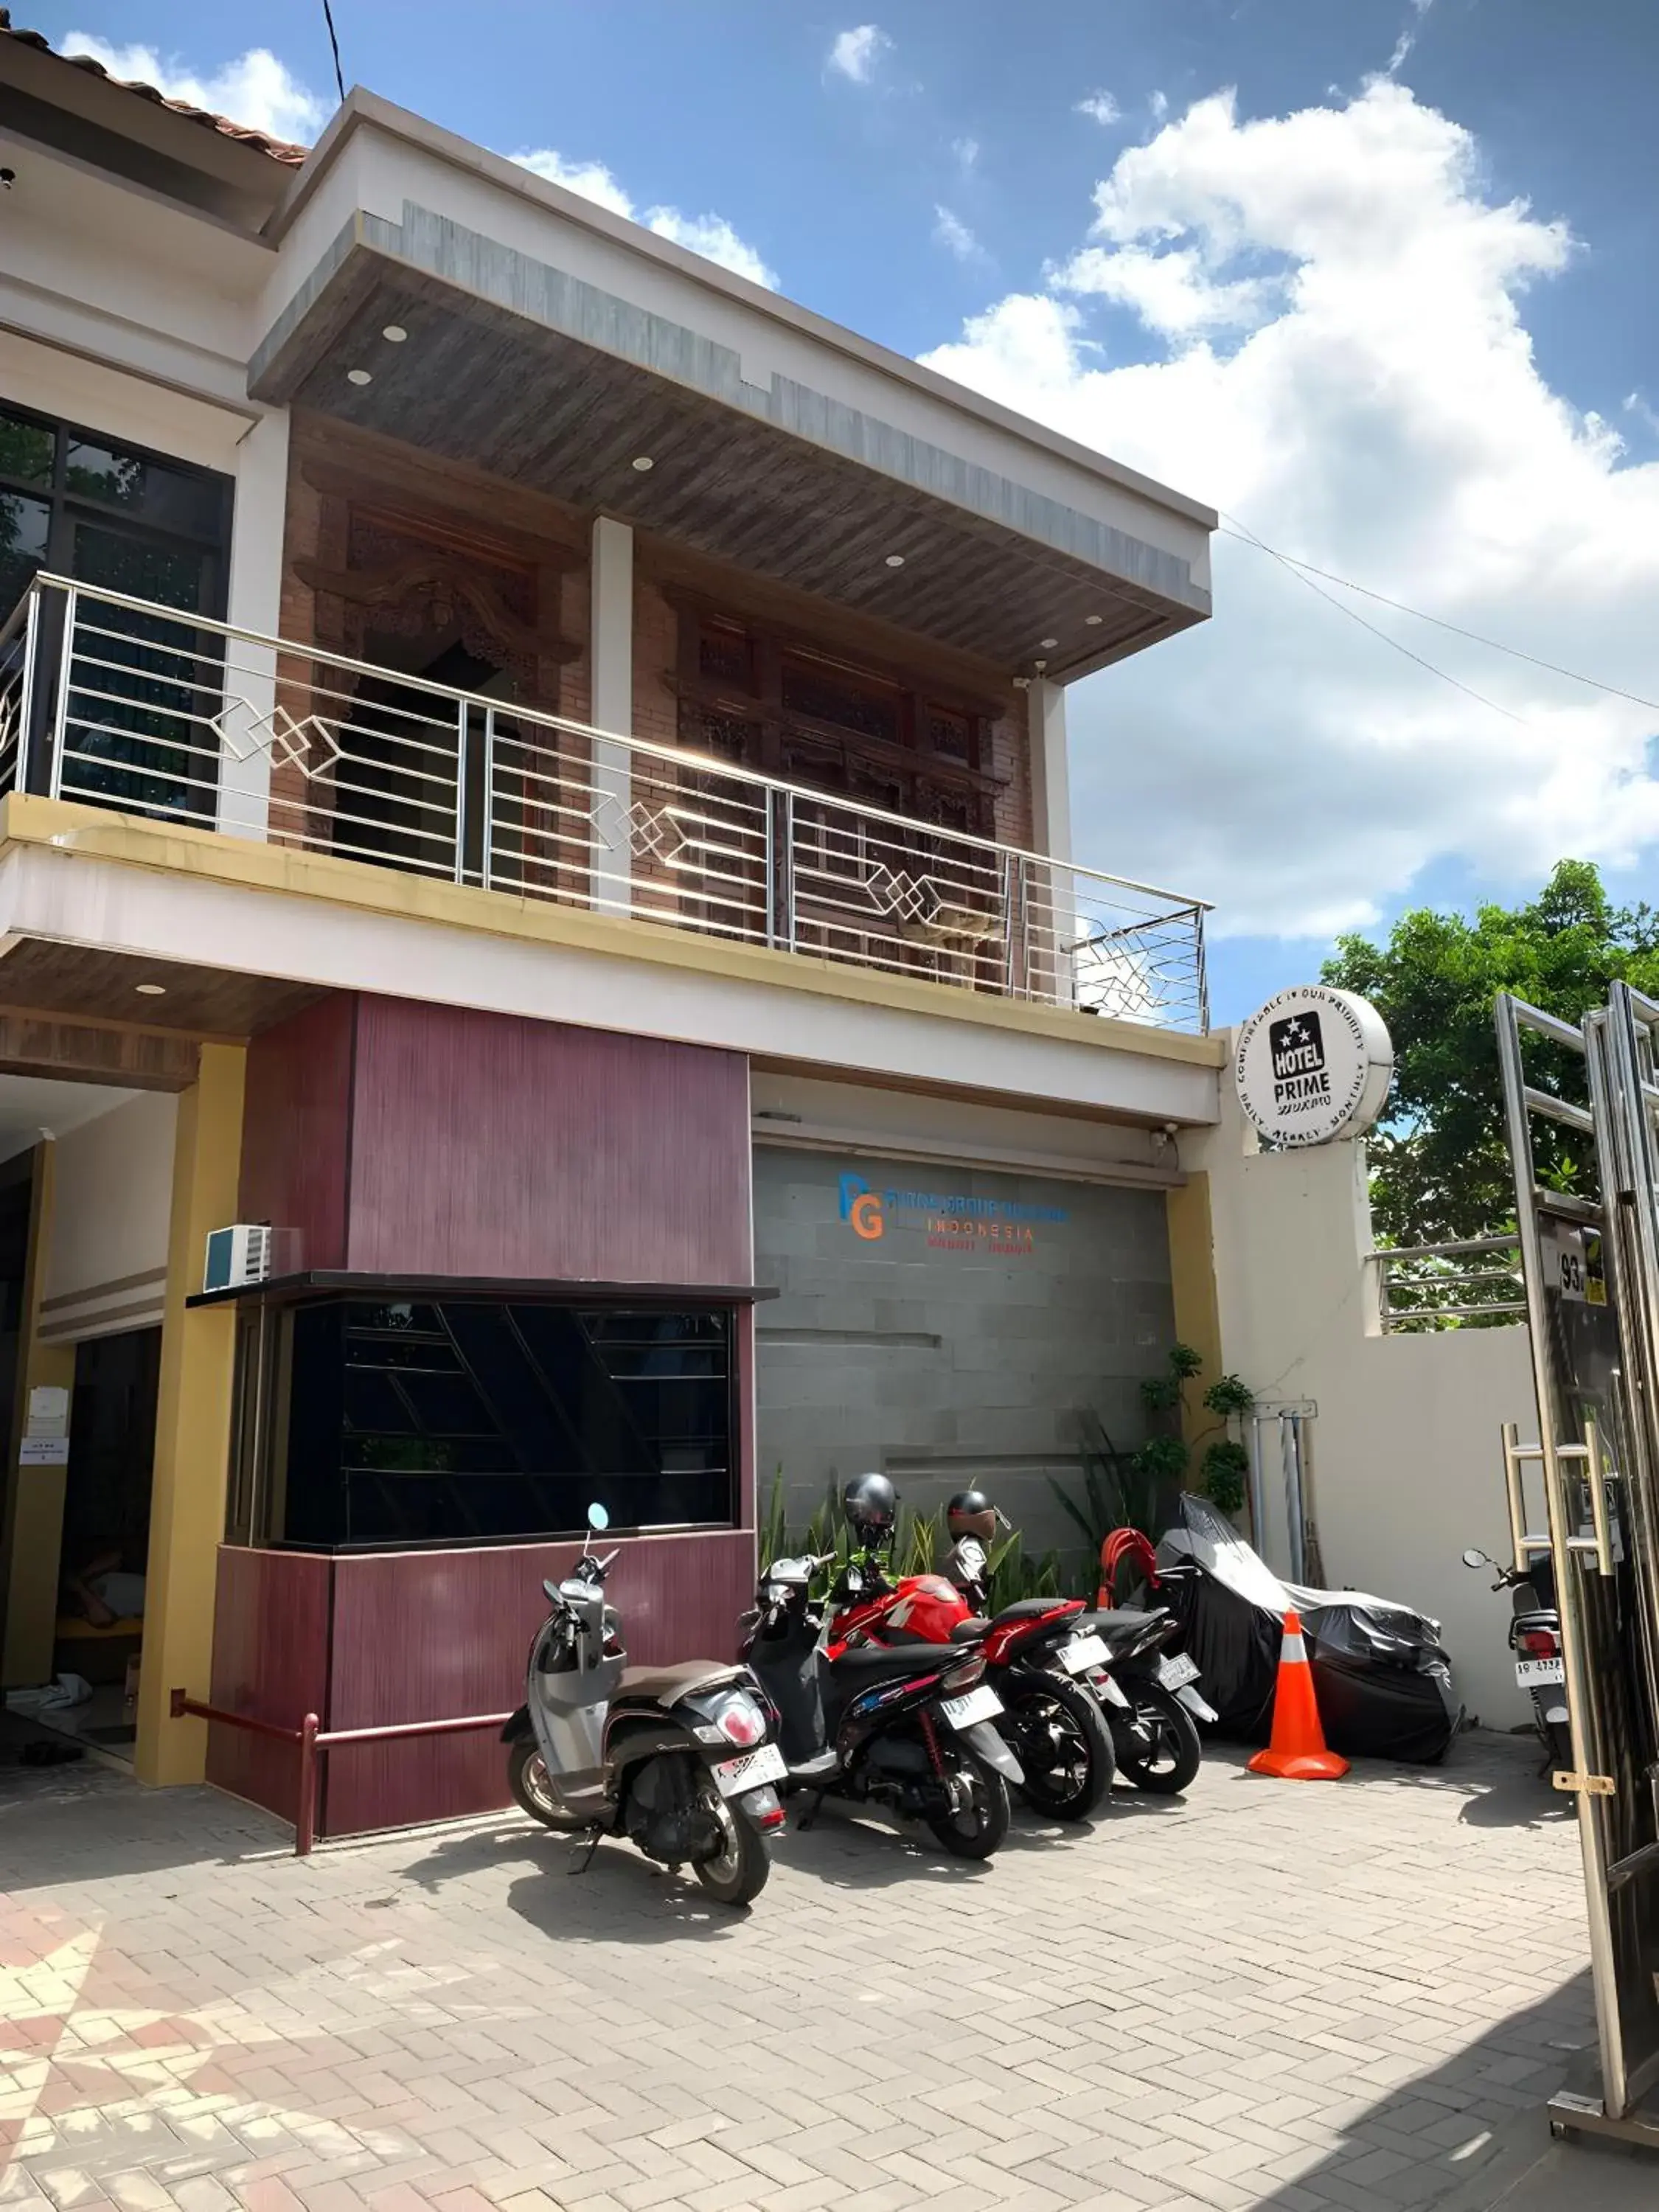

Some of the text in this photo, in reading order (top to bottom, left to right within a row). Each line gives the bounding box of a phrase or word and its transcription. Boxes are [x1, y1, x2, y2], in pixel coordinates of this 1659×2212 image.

[1274, 1042, 1323, 1077] HOTEL
[1274, 1072, 1331, 1104] PRIME
[927, 1217, 1033, 1242] INDONESIA
